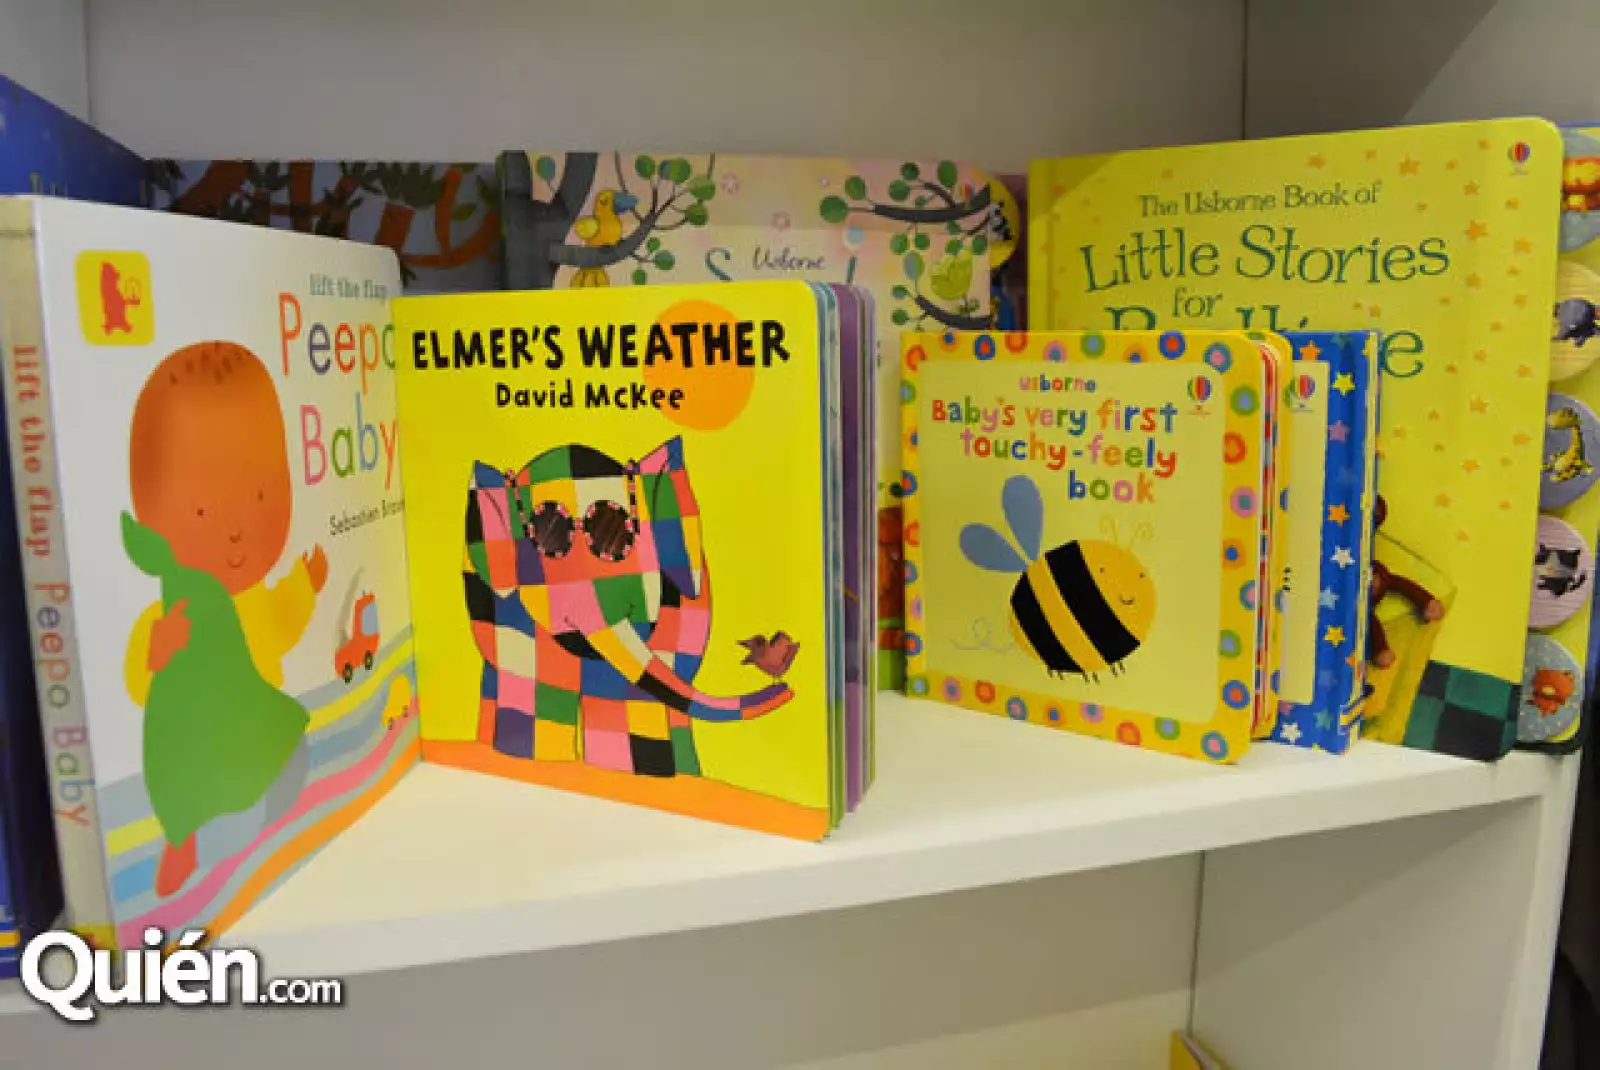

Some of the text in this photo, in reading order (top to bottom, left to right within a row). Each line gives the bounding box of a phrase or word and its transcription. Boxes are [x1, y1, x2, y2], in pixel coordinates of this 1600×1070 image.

[1139, 180, 1382, 218] The Usborne Book of
[752, 246, 828, 270] Usborne
[1080, 223, 1451, 293] Little Stories
[309, 272, 334, 296] lift
[335, 277, 361, 299] the
[1172, 286, 1224, 318] for
[412, 320, 791, 370] ELMER'S WEATHER
[495, 378, 686, 410] David McKee
[1019, 373, 1098, 393] usborne
[932, 396, 1178, 436] Baby's very first
[300, 391, 399, 491] Baby
[960, 427, 1178, 478] touchy-feely
[1068, 469, 1155, 503] book
[13, 346, 96, 826] lift the flap Peepo Baby
